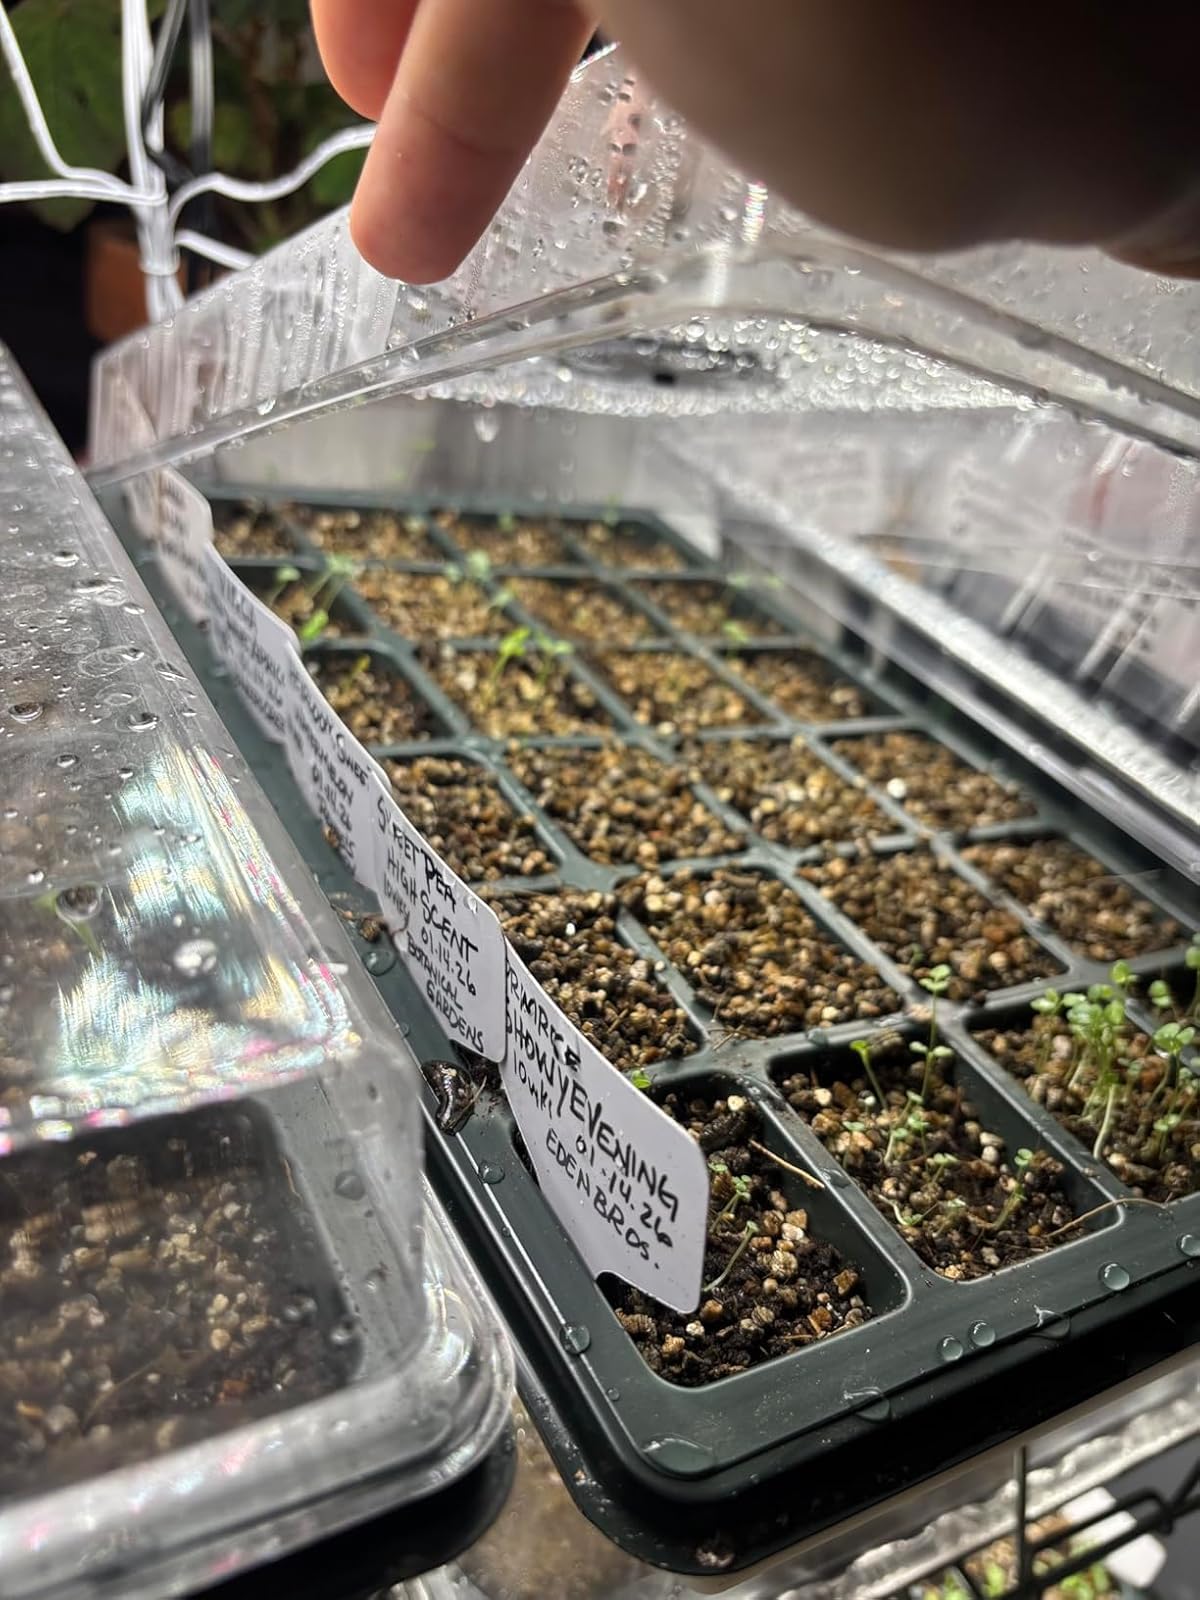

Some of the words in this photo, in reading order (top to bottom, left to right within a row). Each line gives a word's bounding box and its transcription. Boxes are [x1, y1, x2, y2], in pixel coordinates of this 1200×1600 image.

[387, 847, 418, 906] HIGH
[420, 889, 478, 963] SCENT
[420, 848, 457, 914] PEA
[406, 930, 464, 1012] BOTANICAL
[421, 924, 477, 998] 01.14.26
[426, 978, 484, 1055] GARDENS
[545, 1126, 592, 1199] EDEN
[593, 1192, 661, 1271] BROS.
[570, 1082, 680, 1224] EVENING
[575, 1133, 673, 1248] 01.14.26
